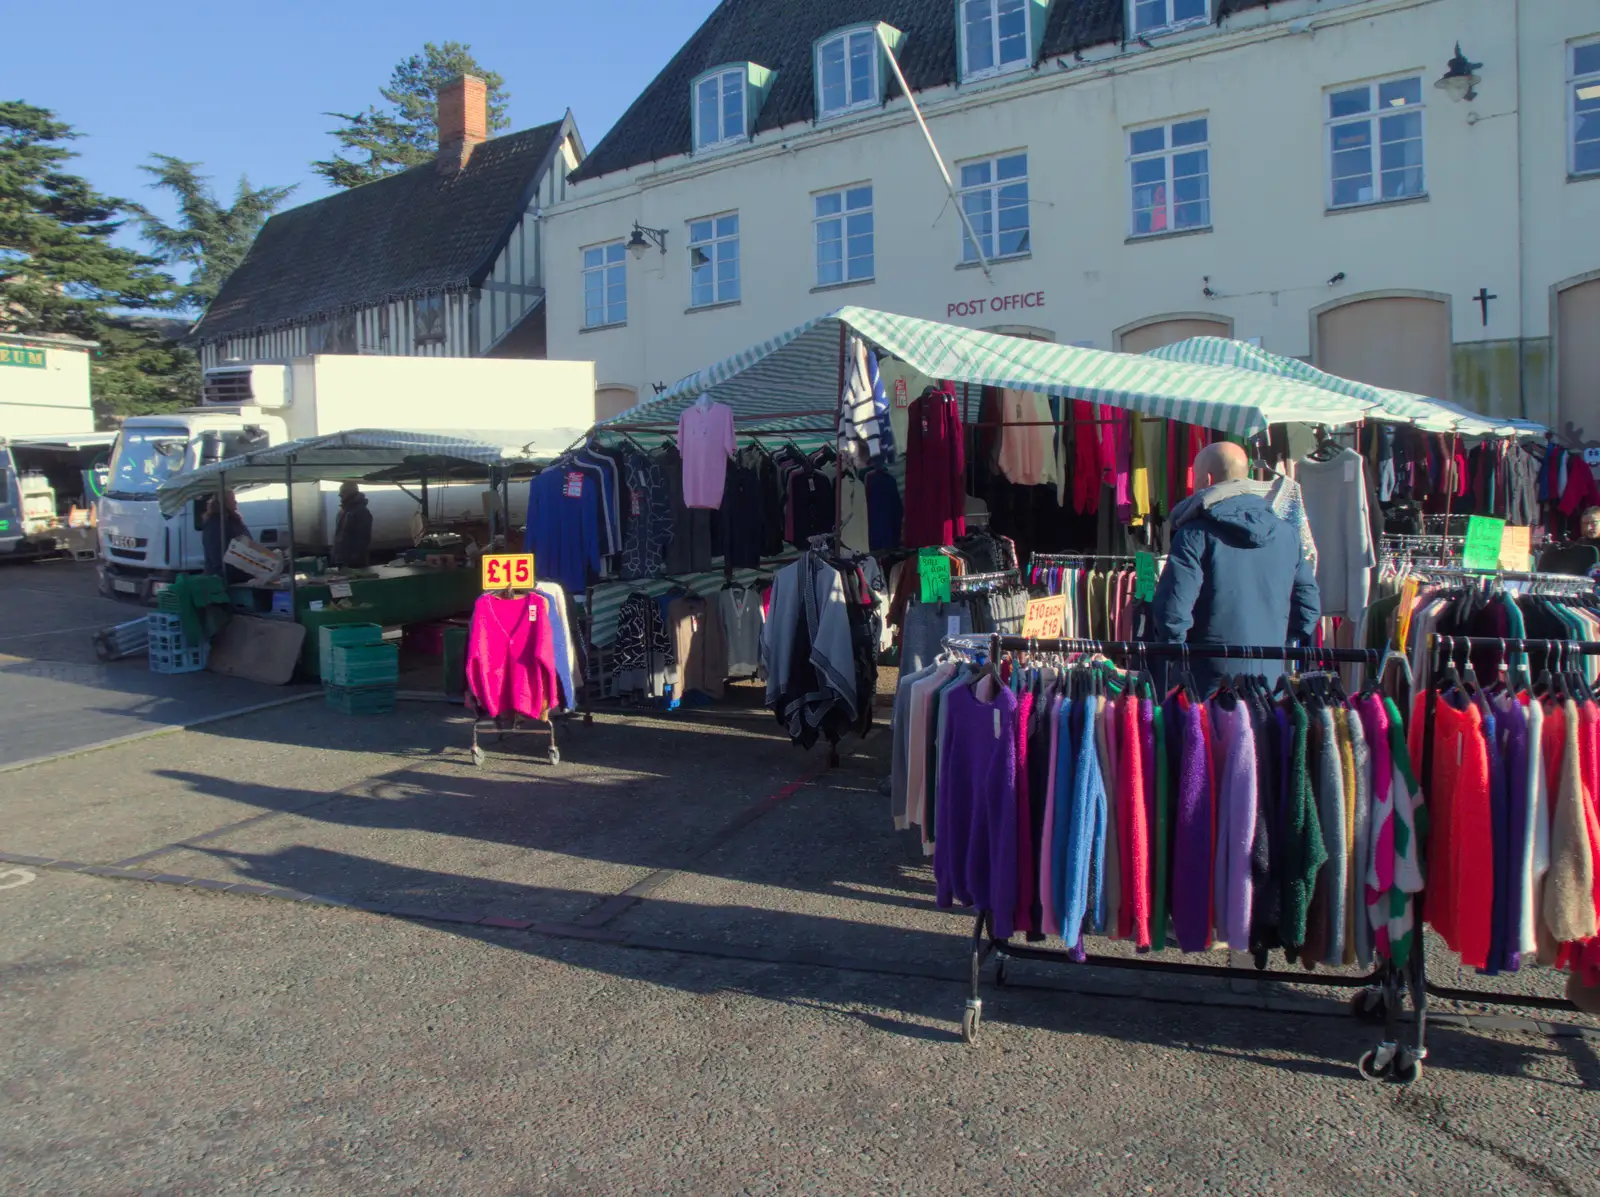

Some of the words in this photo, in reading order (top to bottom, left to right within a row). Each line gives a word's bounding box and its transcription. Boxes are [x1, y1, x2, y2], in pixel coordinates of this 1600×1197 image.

[947, 299, 987, 318] POST
[990, 291, 1045, 312] OFFICE
[487, 559, 529, 583] £15
